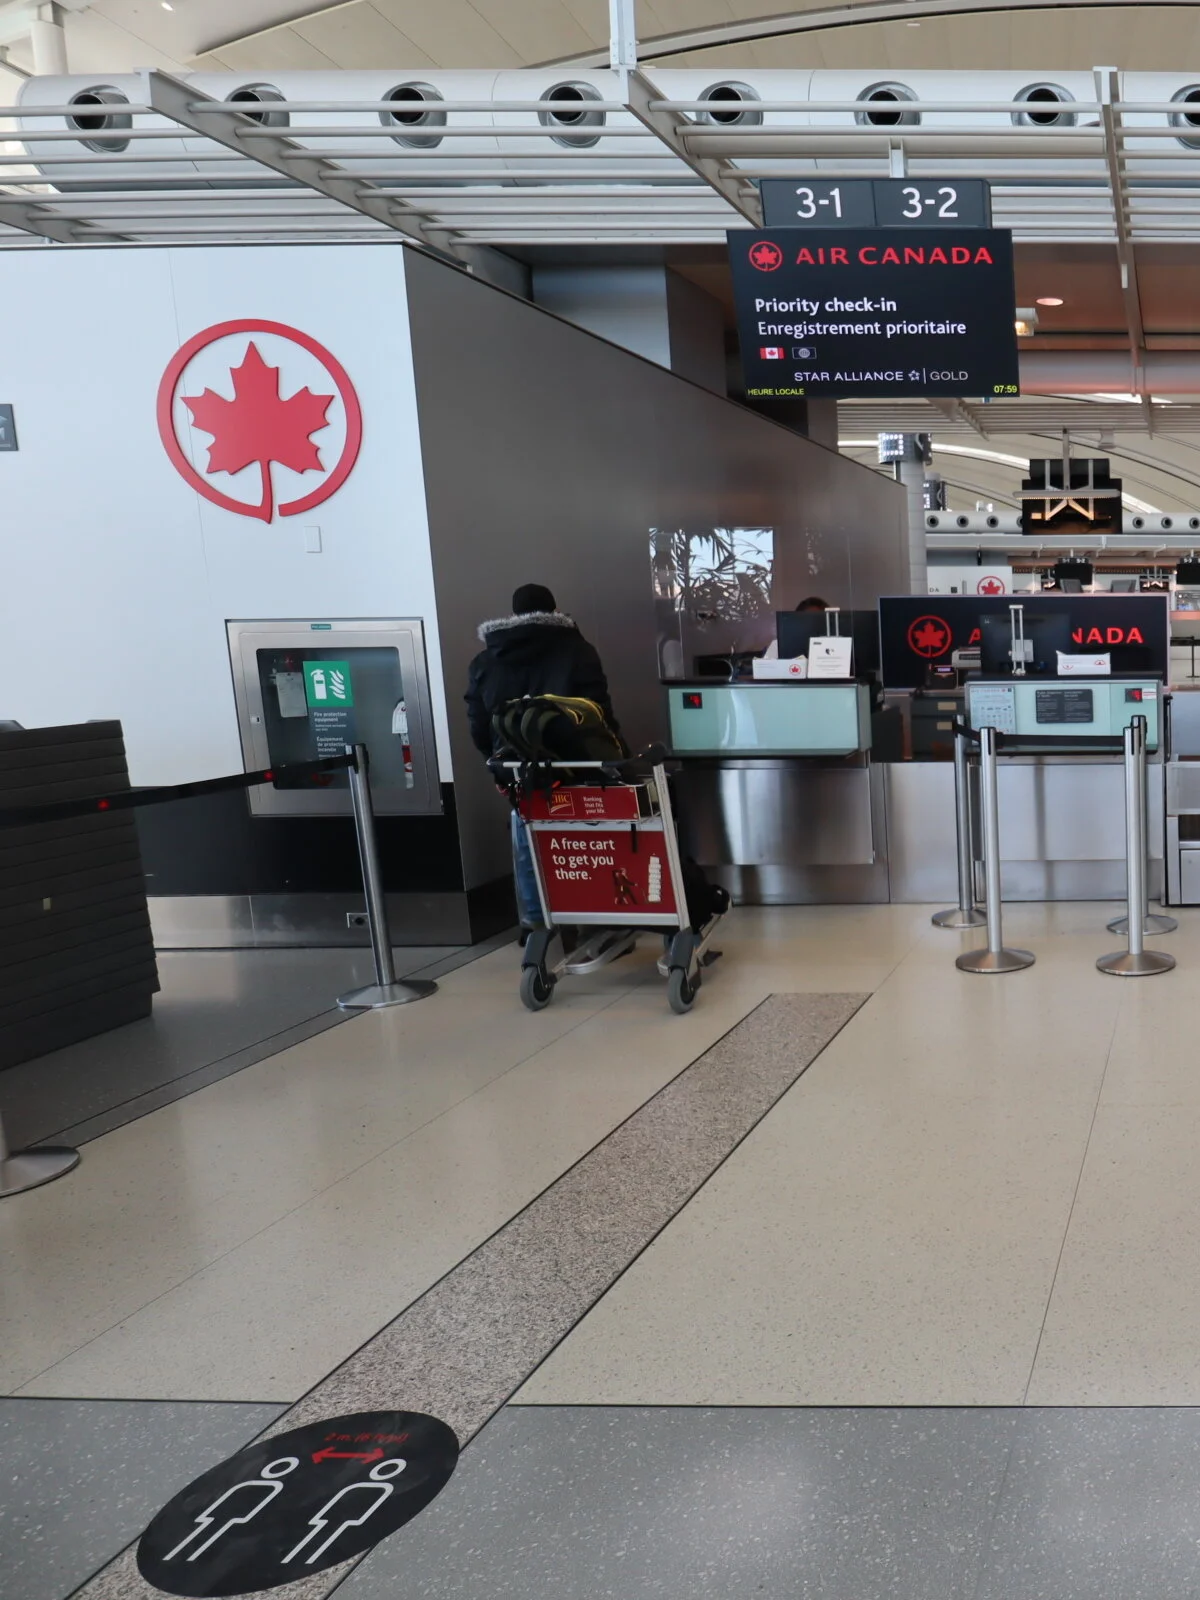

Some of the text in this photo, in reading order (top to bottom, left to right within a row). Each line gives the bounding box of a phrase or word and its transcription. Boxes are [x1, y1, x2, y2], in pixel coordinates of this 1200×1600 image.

[795, 187, 959, 218] 3-1 3-2
[796, 247, 993, 265] AIR CANADA
[755, 297, 897, 316] Priority check-in
[758, 320, 967, 339] Enregistrement prioritaire
[794, 371, 904, 382] STAR ALLIANCE
[930, 370, 969, 381] GOLD
[748, 388, 805, 396] HEURE LOCALE
[993, 384, 1018, 394] 07:59
[1071, 626, 1145, 644] NADA
[550, 837, 616, 850] A free cart
[552, 854, 614, 869] to get you
[555, 868, 592, 881] there.
